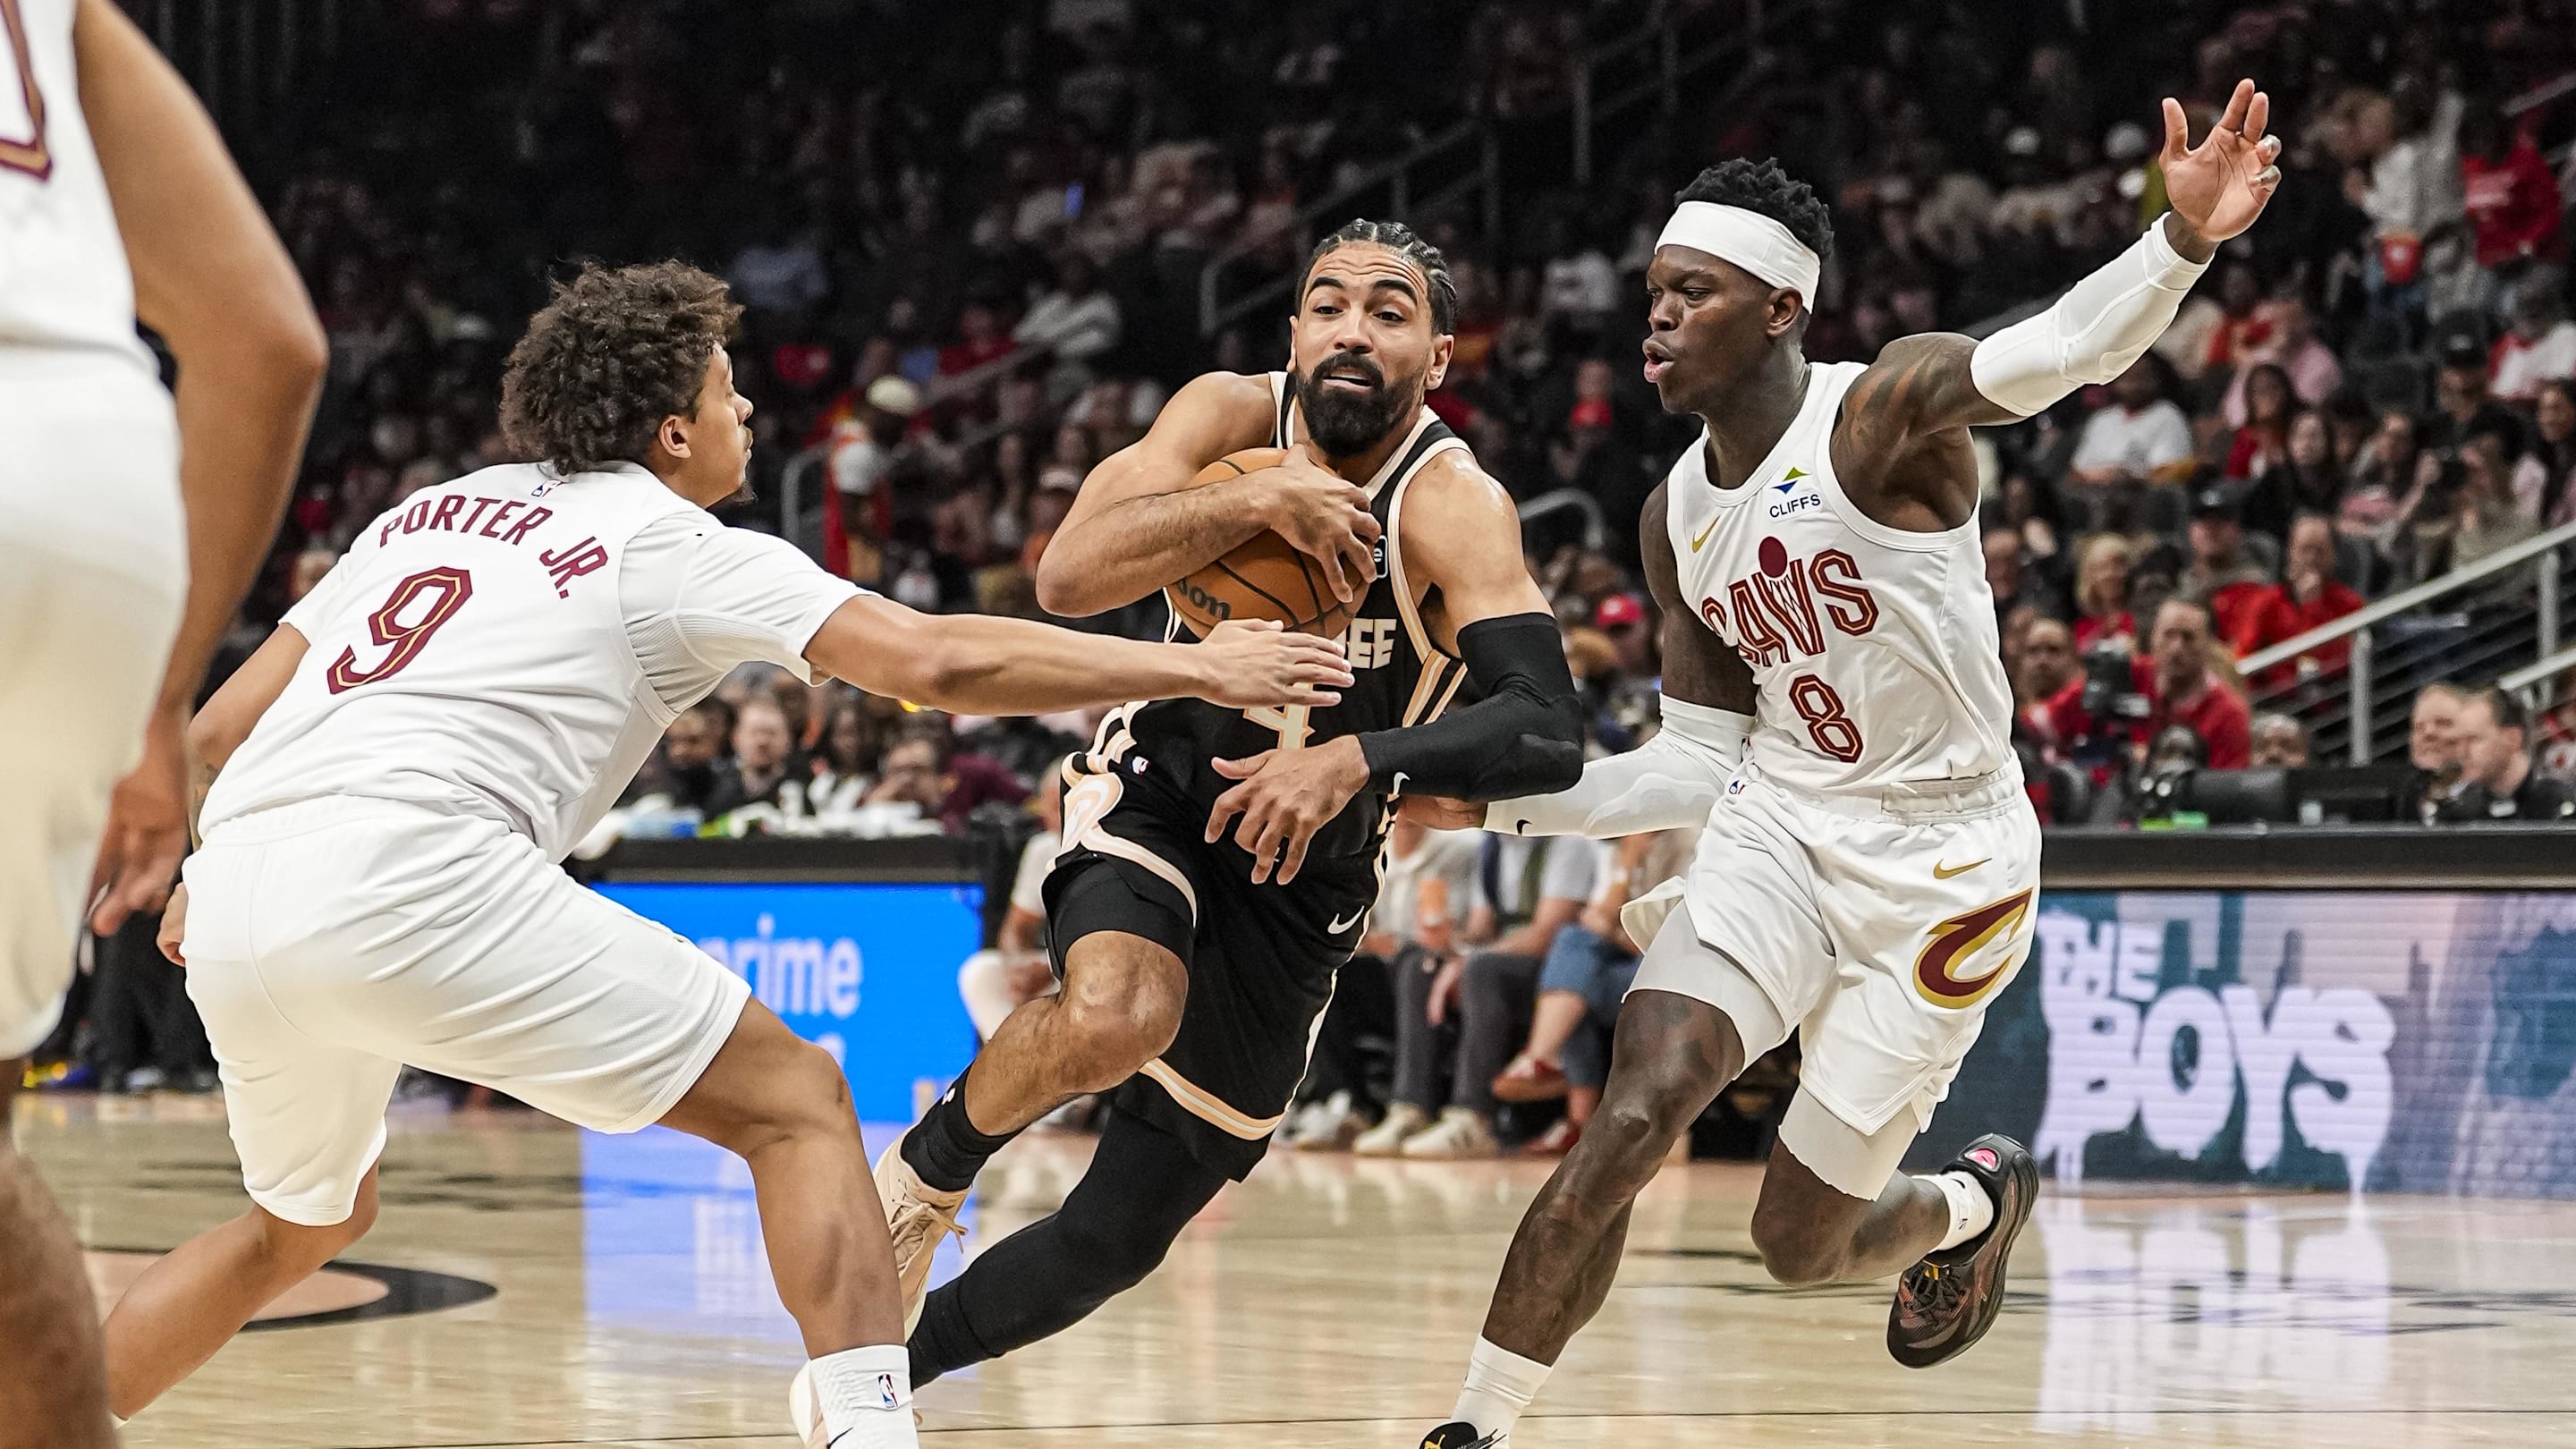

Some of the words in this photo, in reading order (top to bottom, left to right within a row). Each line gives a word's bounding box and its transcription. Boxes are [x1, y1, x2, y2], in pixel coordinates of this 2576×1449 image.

[379, 495, 553, 547] PORTER
[539, 536, 608, 599] JR.
[1769, 494, 1821, 519] CLIFFS
[327, 566, 473, 695] 9
[1789, 674, 1864, 764] 8
[2036, 907, 2165, 1003] THE
[2032, 986, 2397, 1197] BOYS
